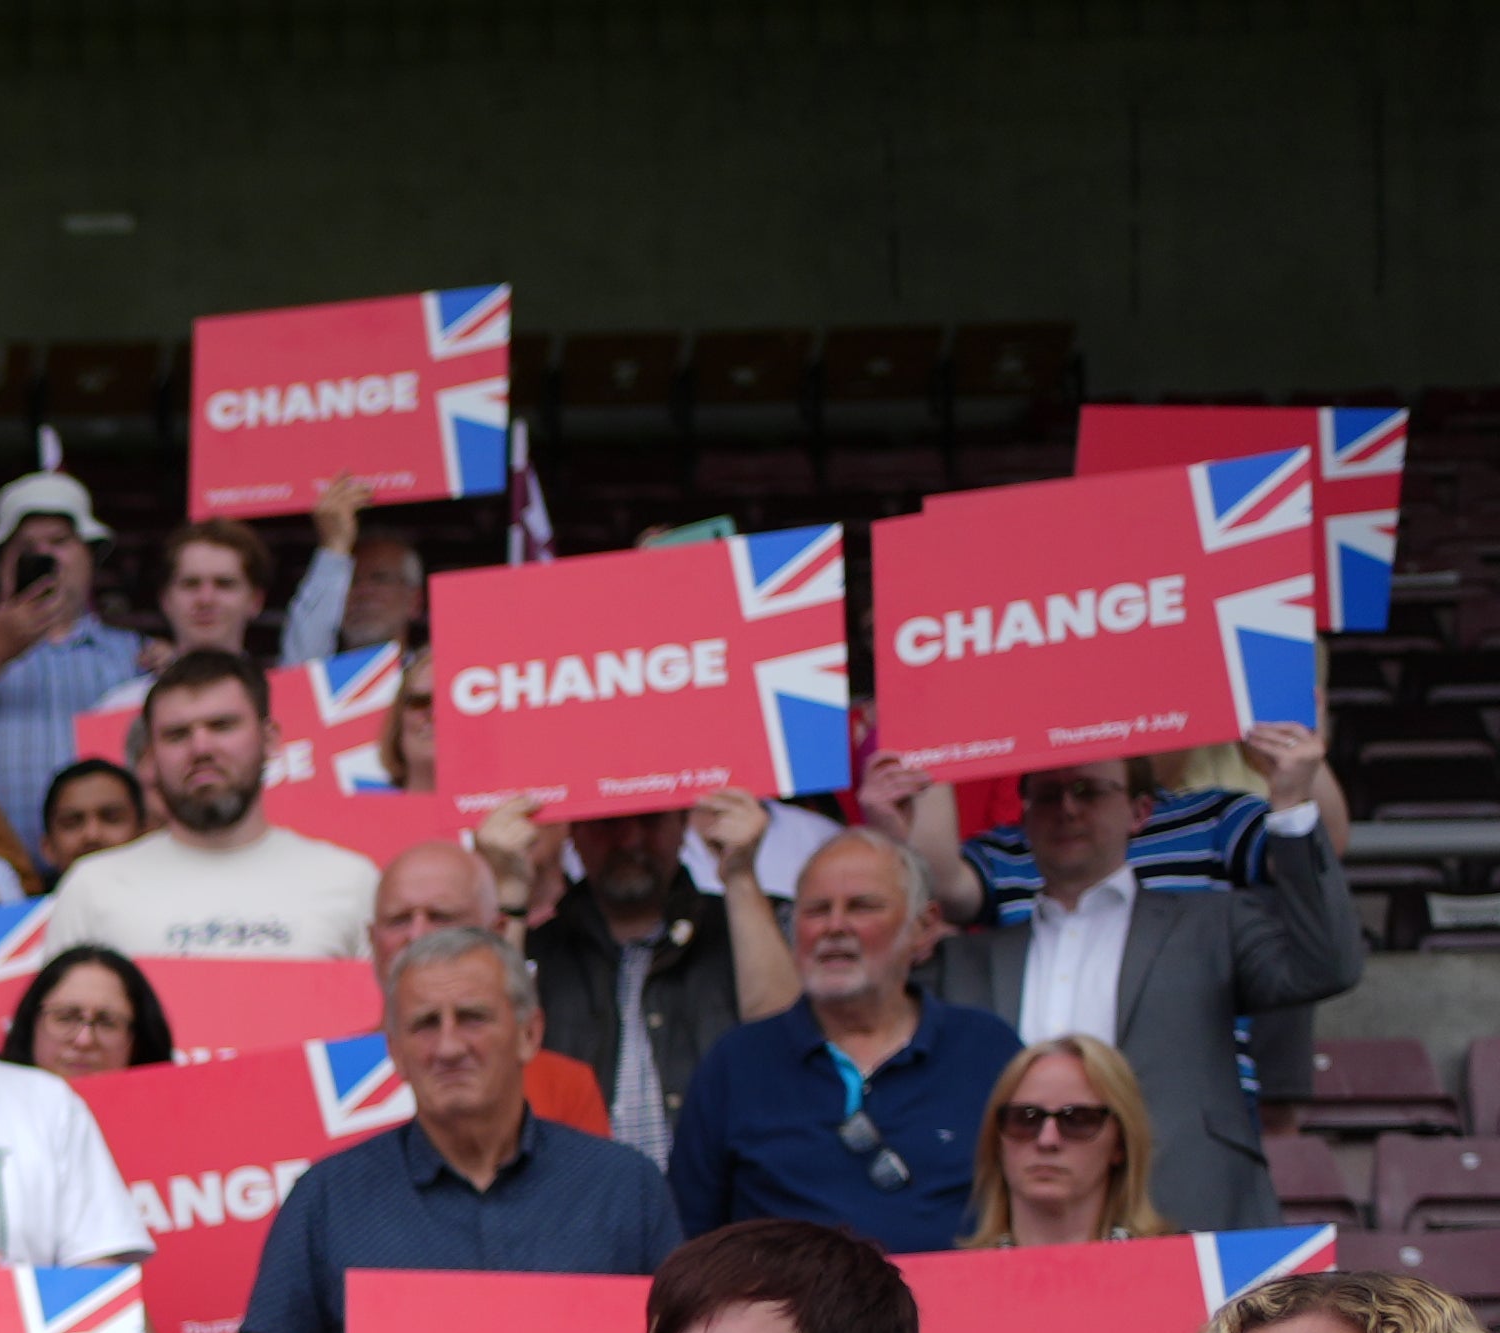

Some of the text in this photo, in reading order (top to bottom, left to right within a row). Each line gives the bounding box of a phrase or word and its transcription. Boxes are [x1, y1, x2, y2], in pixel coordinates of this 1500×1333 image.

[206, 372, 418, 429] CHANGE
[895, 575, 1185, 666] CHANGE
[452, 639, 727, 714] CHANGE
